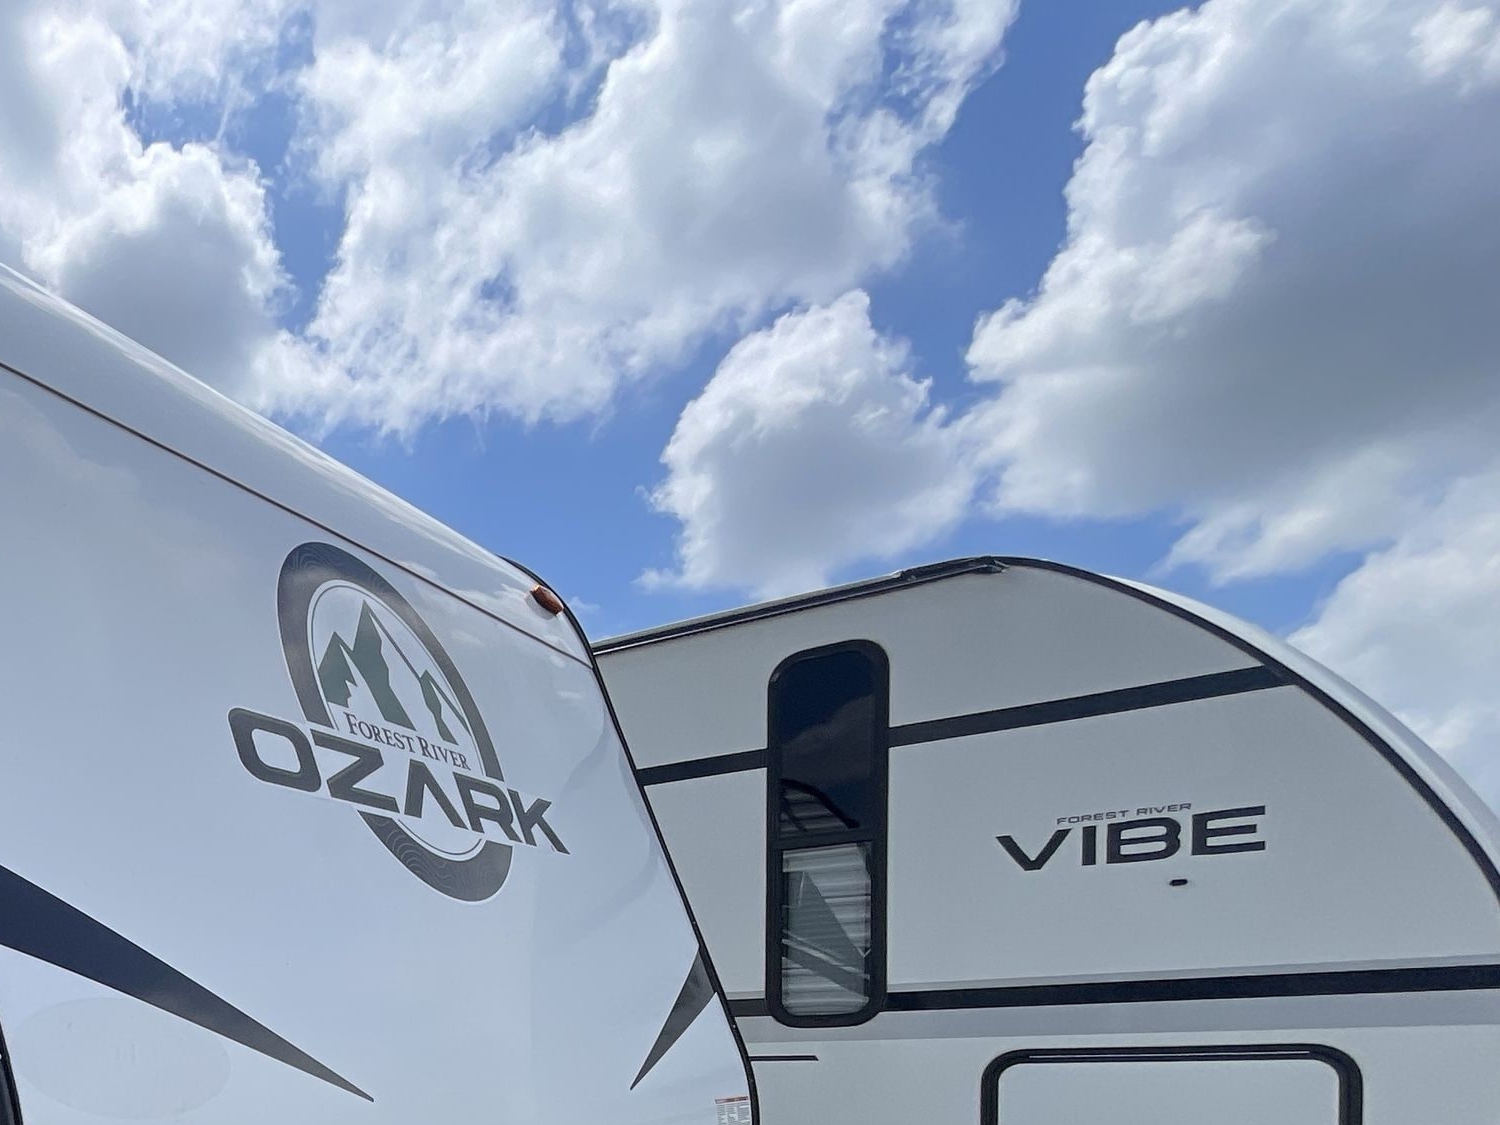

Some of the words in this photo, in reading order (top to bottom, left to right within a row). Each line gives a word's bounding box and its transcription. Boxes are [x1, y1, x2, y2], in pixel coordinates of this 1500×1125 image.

[343, 711, 416, 754] FOREST
[416, 735, 472, 771] RIVER
[227, 707, 571, 856] OZARK
[995, 805, 1266, 871] VIBE
[1056, 809, 1130, 826] FOREST
[1136, 802, 1192, 817] RIVER
